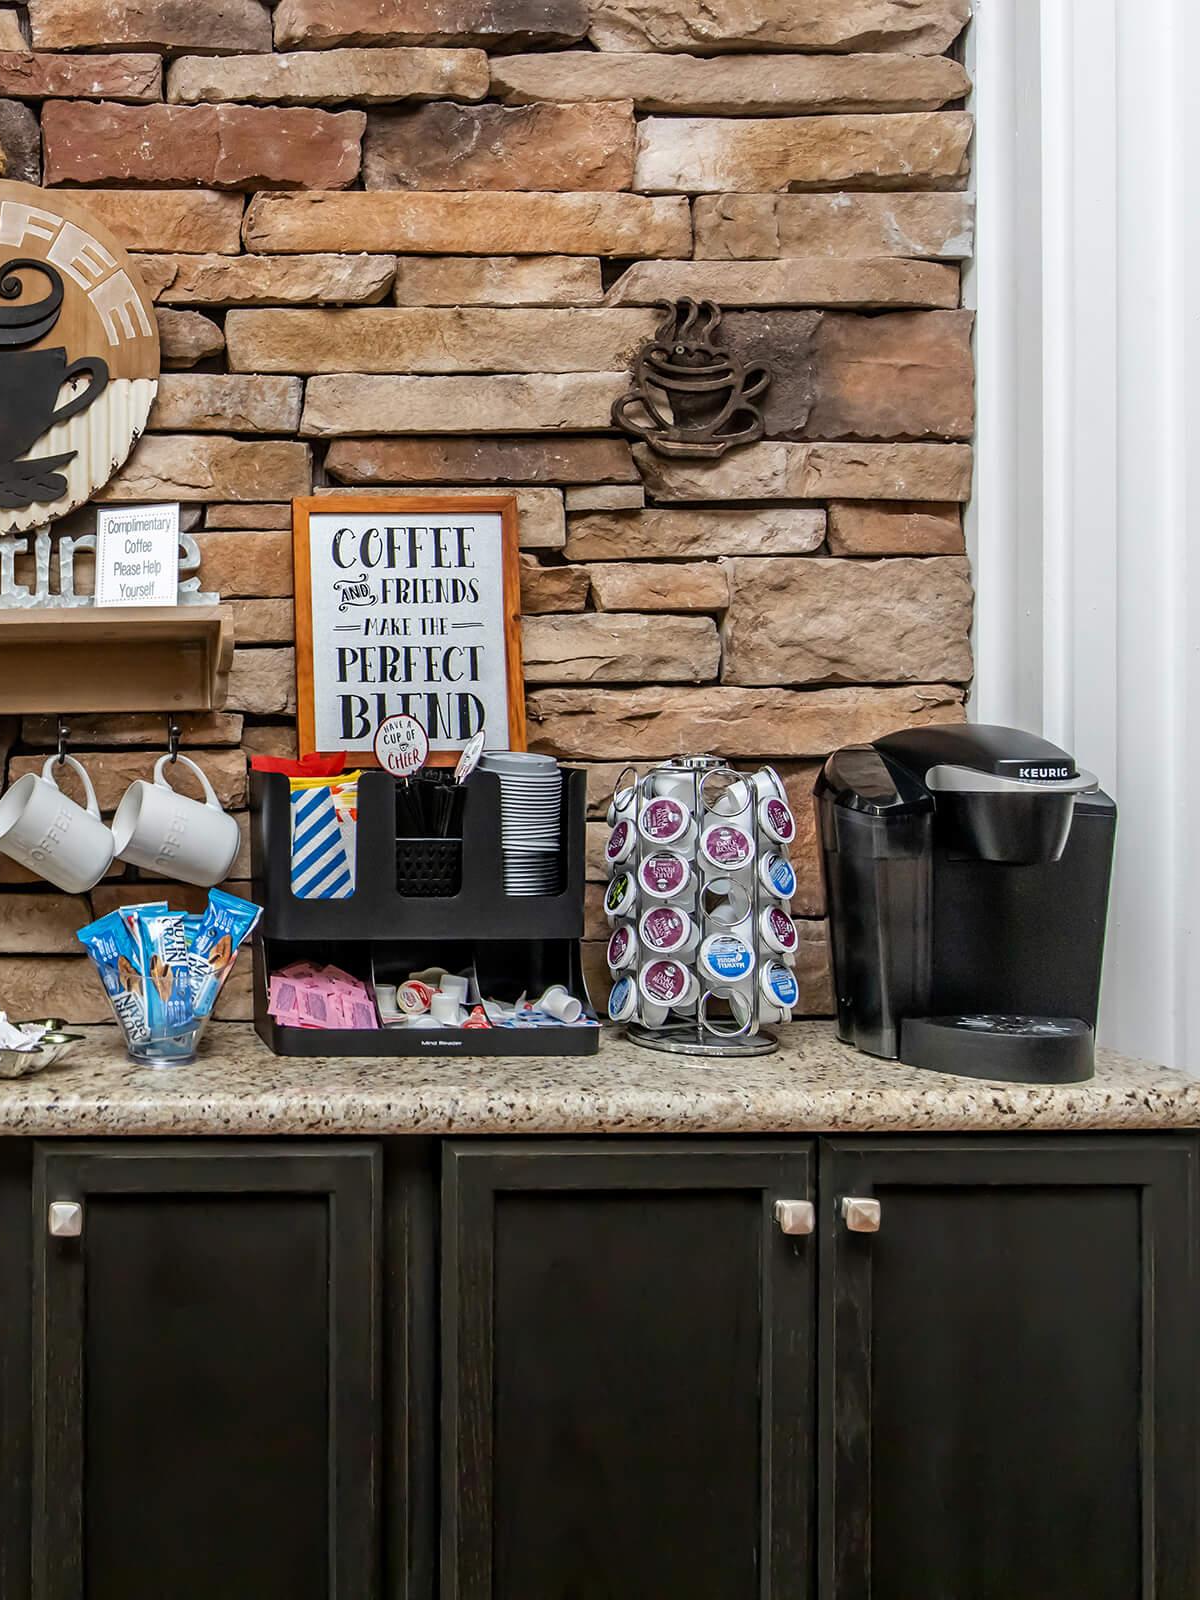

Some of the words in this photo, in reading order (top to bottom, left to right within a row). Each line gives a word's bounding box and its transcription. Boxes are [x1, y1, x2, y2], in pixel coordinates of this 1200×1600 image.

[107, 518, 171, 535] Complimentary
[124, 538, 152, 554] Coffee
[331, 526, 475, 569] COFFEE
[113, 561, 141, 576] Please
[142, 559, 162, 576] Help
[119, 581, 155, 598] Yourself
[341, 582, 371, 603] AND
[380, 577, 480, 605] FRIENDS
[363, 618, 412, 637] MAKE
[418, 617, 449, 636] THE
[335, 645, 485, 683] PERFECT
[383, 720, 403, 734] HAVE
[406, 720, 413, 729] A
[383, 732, 402, 746] CUP
[406, 728, 416, 741] OF
[387, 748, 422, 770] CHEER
[1019, 767, 1069, 778] KEURIG
[172, 916, 188, 963] NUTRI
[114, 998, 141, 1042] NUTRI
[120, 993, 148, 1038] GRAIN
